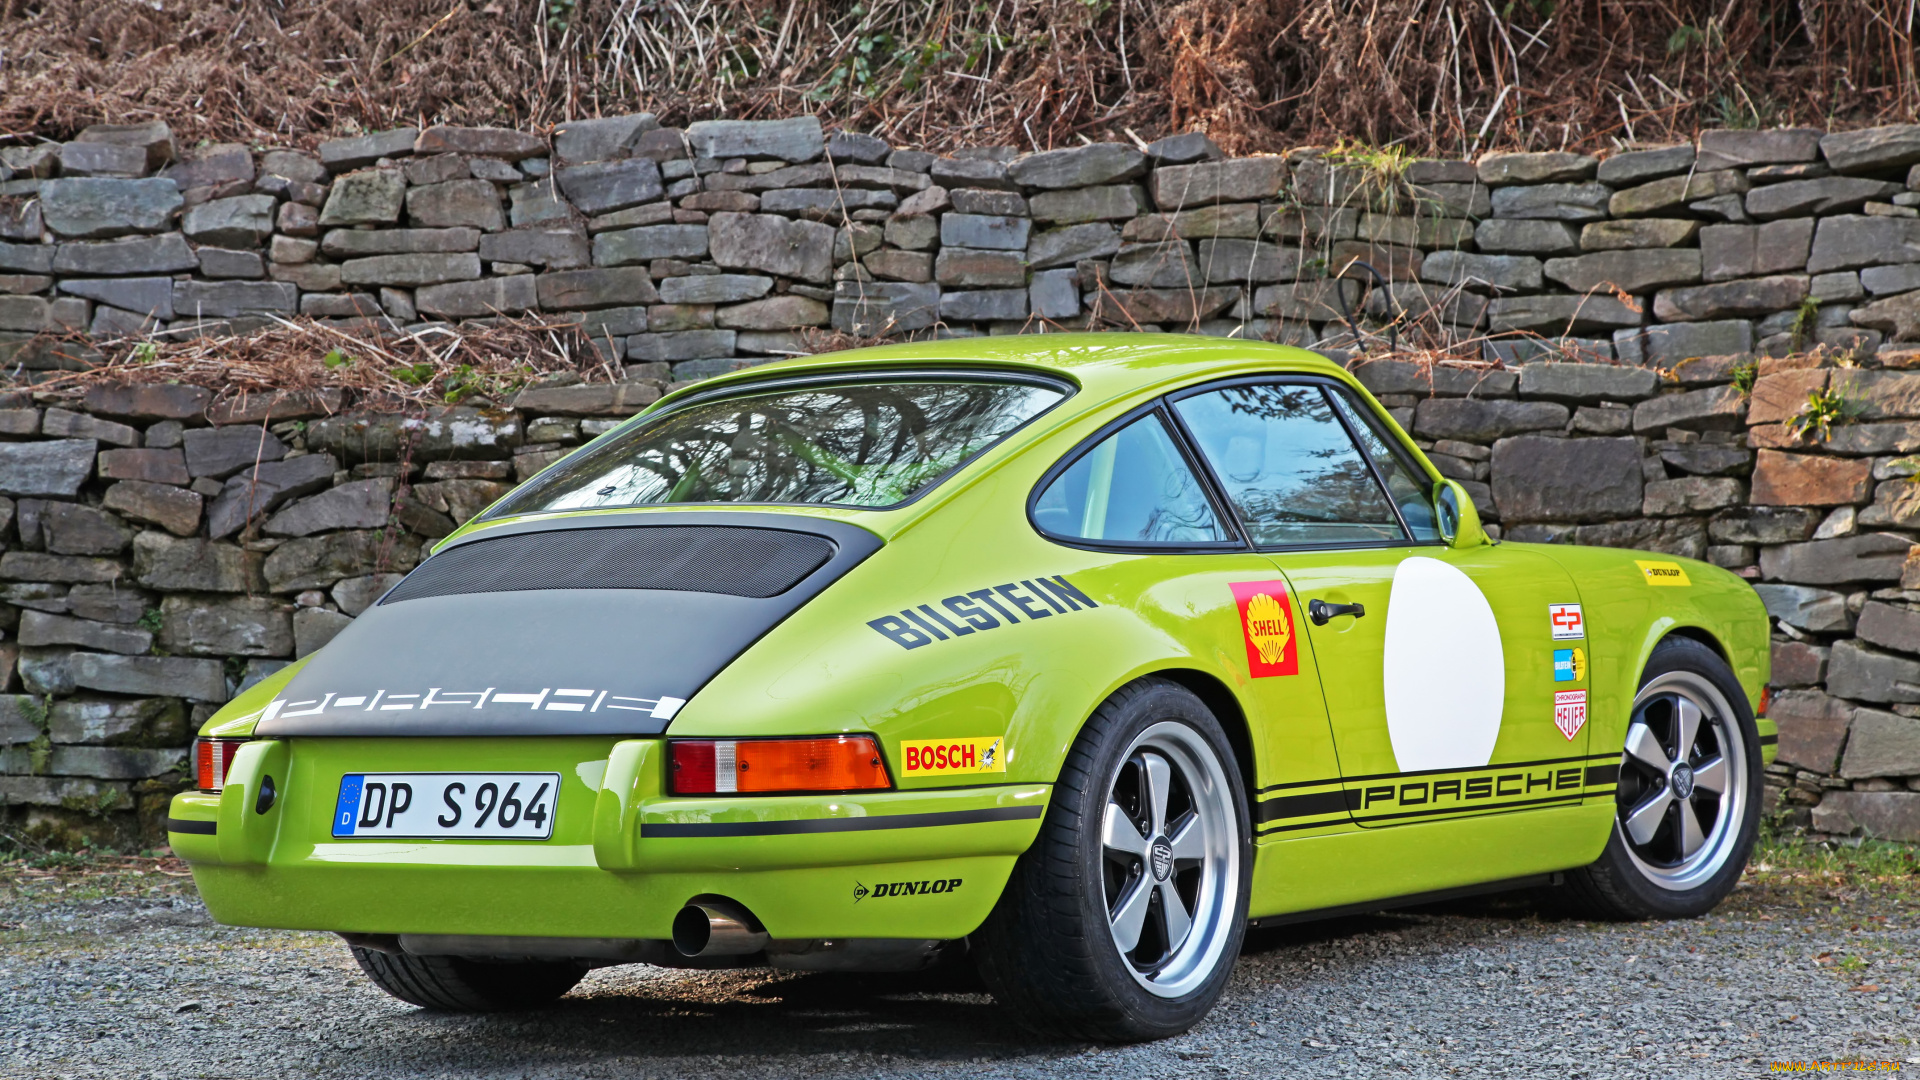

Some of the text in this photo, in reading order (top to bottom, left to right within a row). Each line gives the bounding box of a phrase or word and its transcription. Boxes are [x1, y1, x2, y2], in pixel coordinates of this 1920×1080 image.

[1652, 568, 1680, 577] DUNLOP
[866, 574, 1099, 651] BILSTEIN
[1252, 619, 1284, 637] SHELL
[1557, 693, 1585, 701] CHRONOGRAPH
[1557, 706, 1585, 736] HEUER
[906, 744, 976, 771] BOSCH
[1364, 767, 1582, 810] PORSCHE
[358, 782, 550, 829] DP S 964
[341, 811, 351, 826] D
[871, 878, 963, 898] DUNLOP
